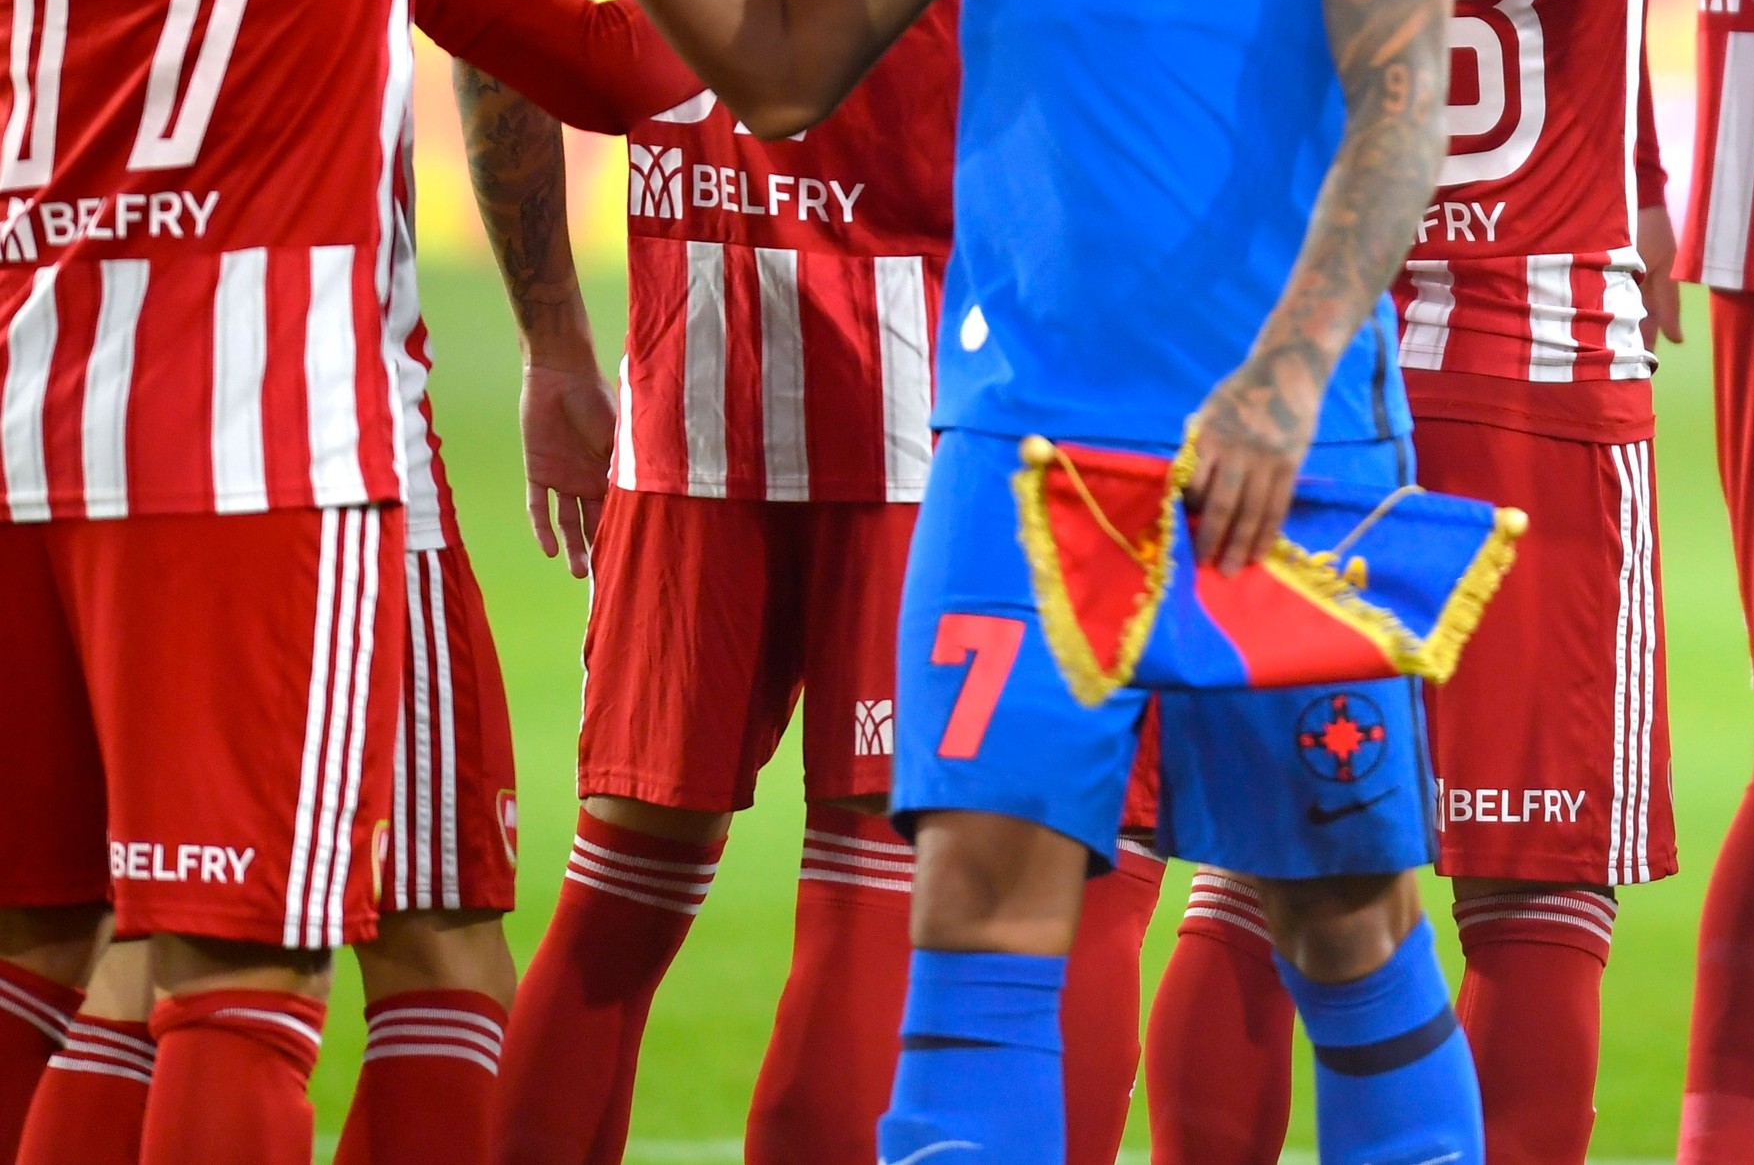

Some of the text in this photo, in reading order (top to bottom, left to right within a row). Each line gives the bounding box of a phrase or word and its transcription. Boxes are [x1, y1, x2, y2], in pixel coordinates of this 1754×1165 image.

[692, 163, 865, 223] BELFRY
[930, 613, 1026, 760] 7
[1449, 789, 1586, 822] BELFRY
[110, 841, 256, 884] BELFRY
